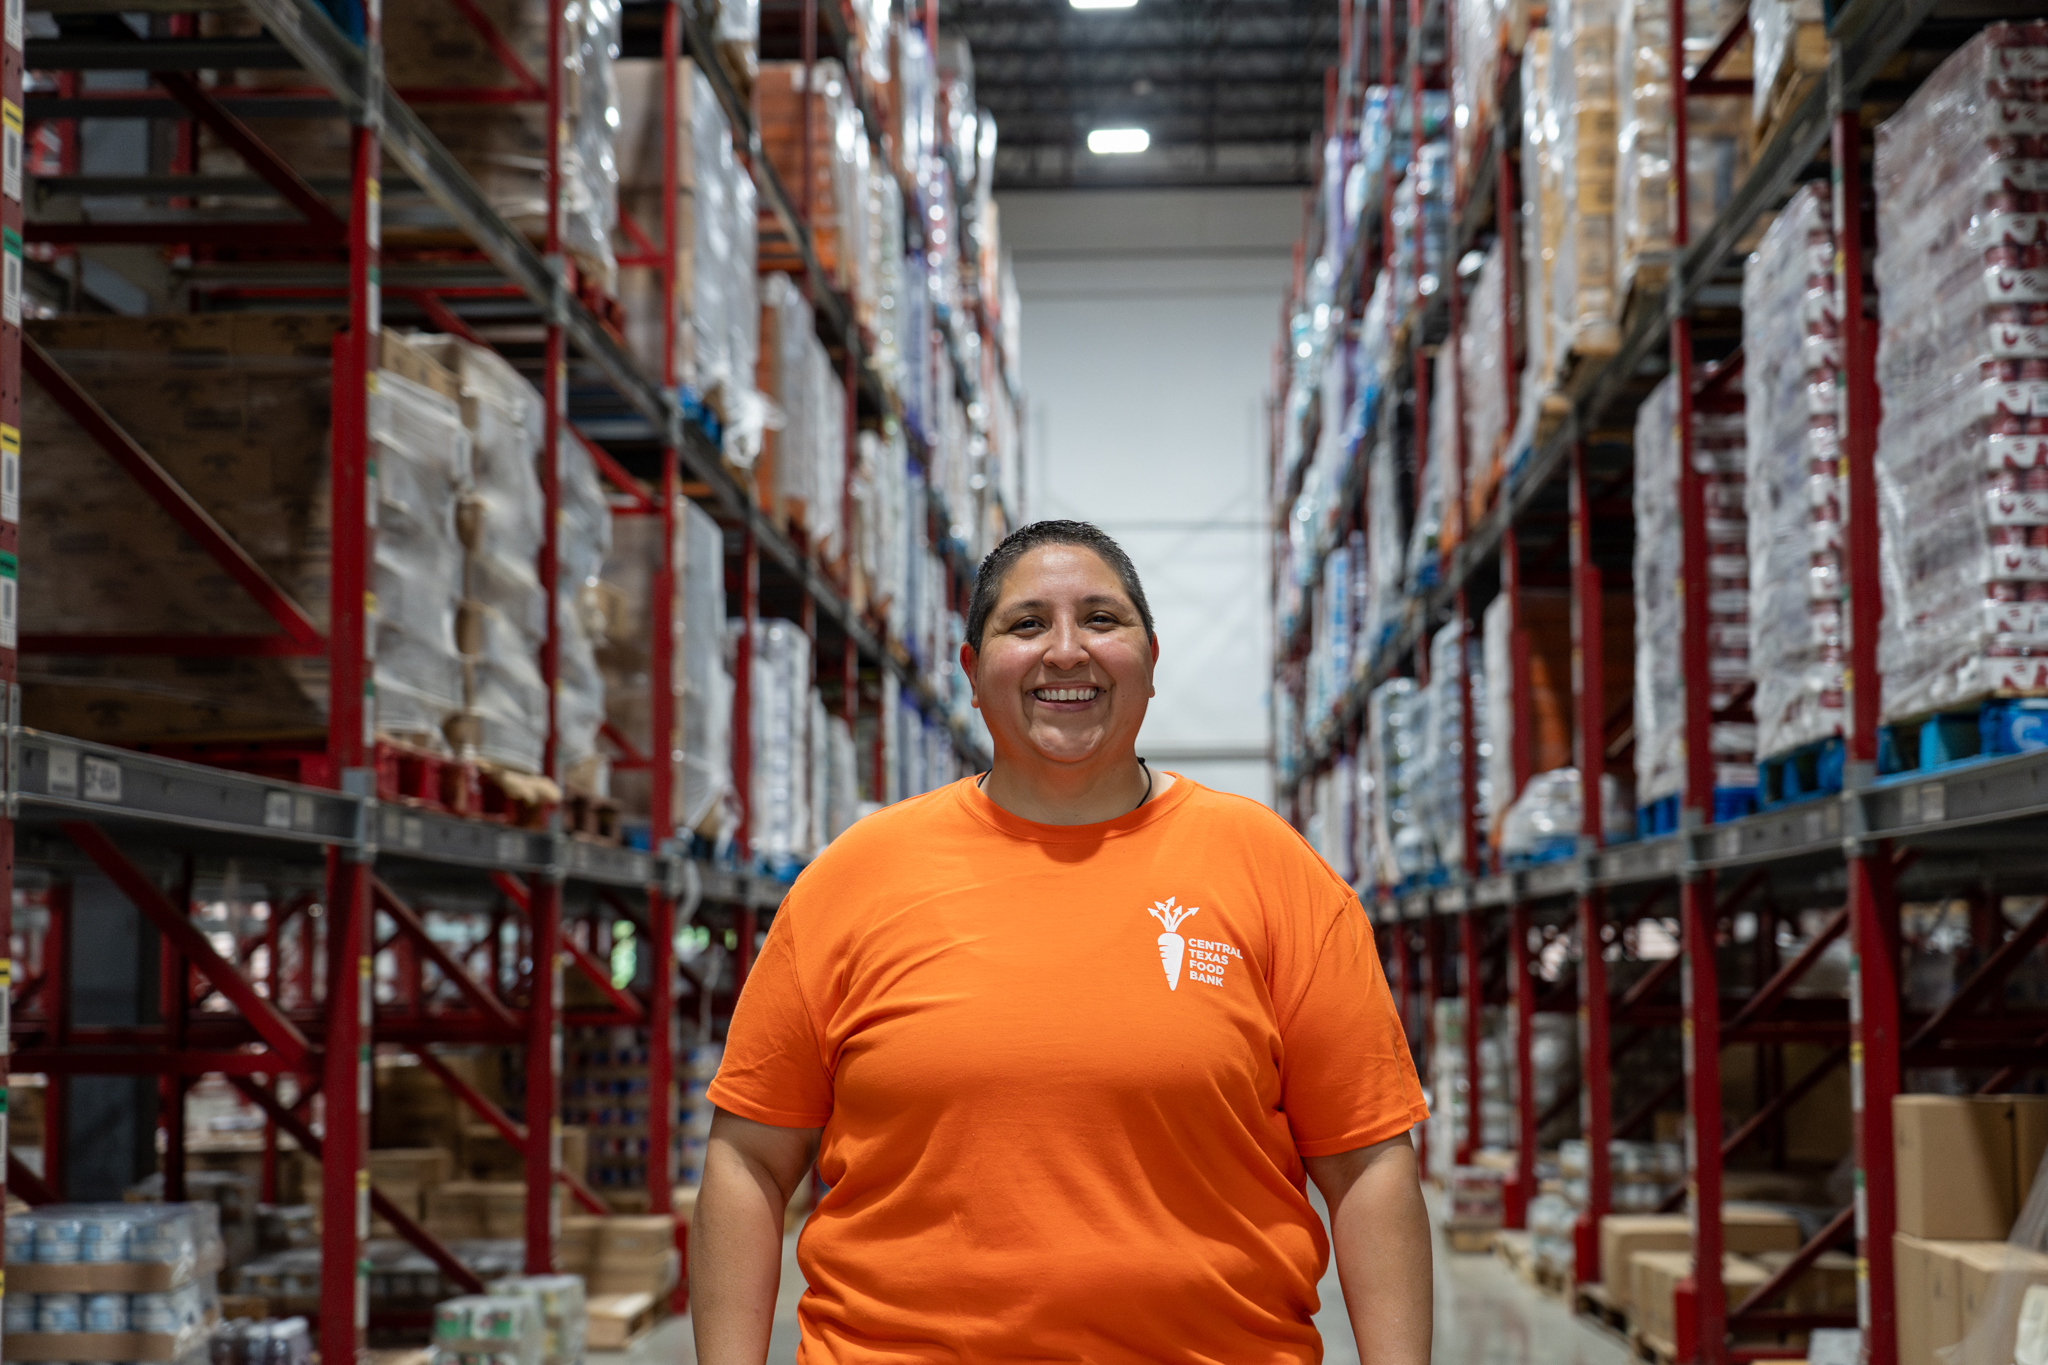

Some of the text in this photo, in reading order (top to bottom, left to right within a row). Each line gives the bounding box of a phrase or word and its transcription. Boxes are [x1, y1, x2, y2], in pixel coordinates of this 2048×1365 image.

[1188, 938, 1243, 960] CENTRAL
[1188, 948, 1229, 965] TEXAS
[1189, 959, 1225, 975] FOOD
[1189, 970, 1224, 987] BANK
